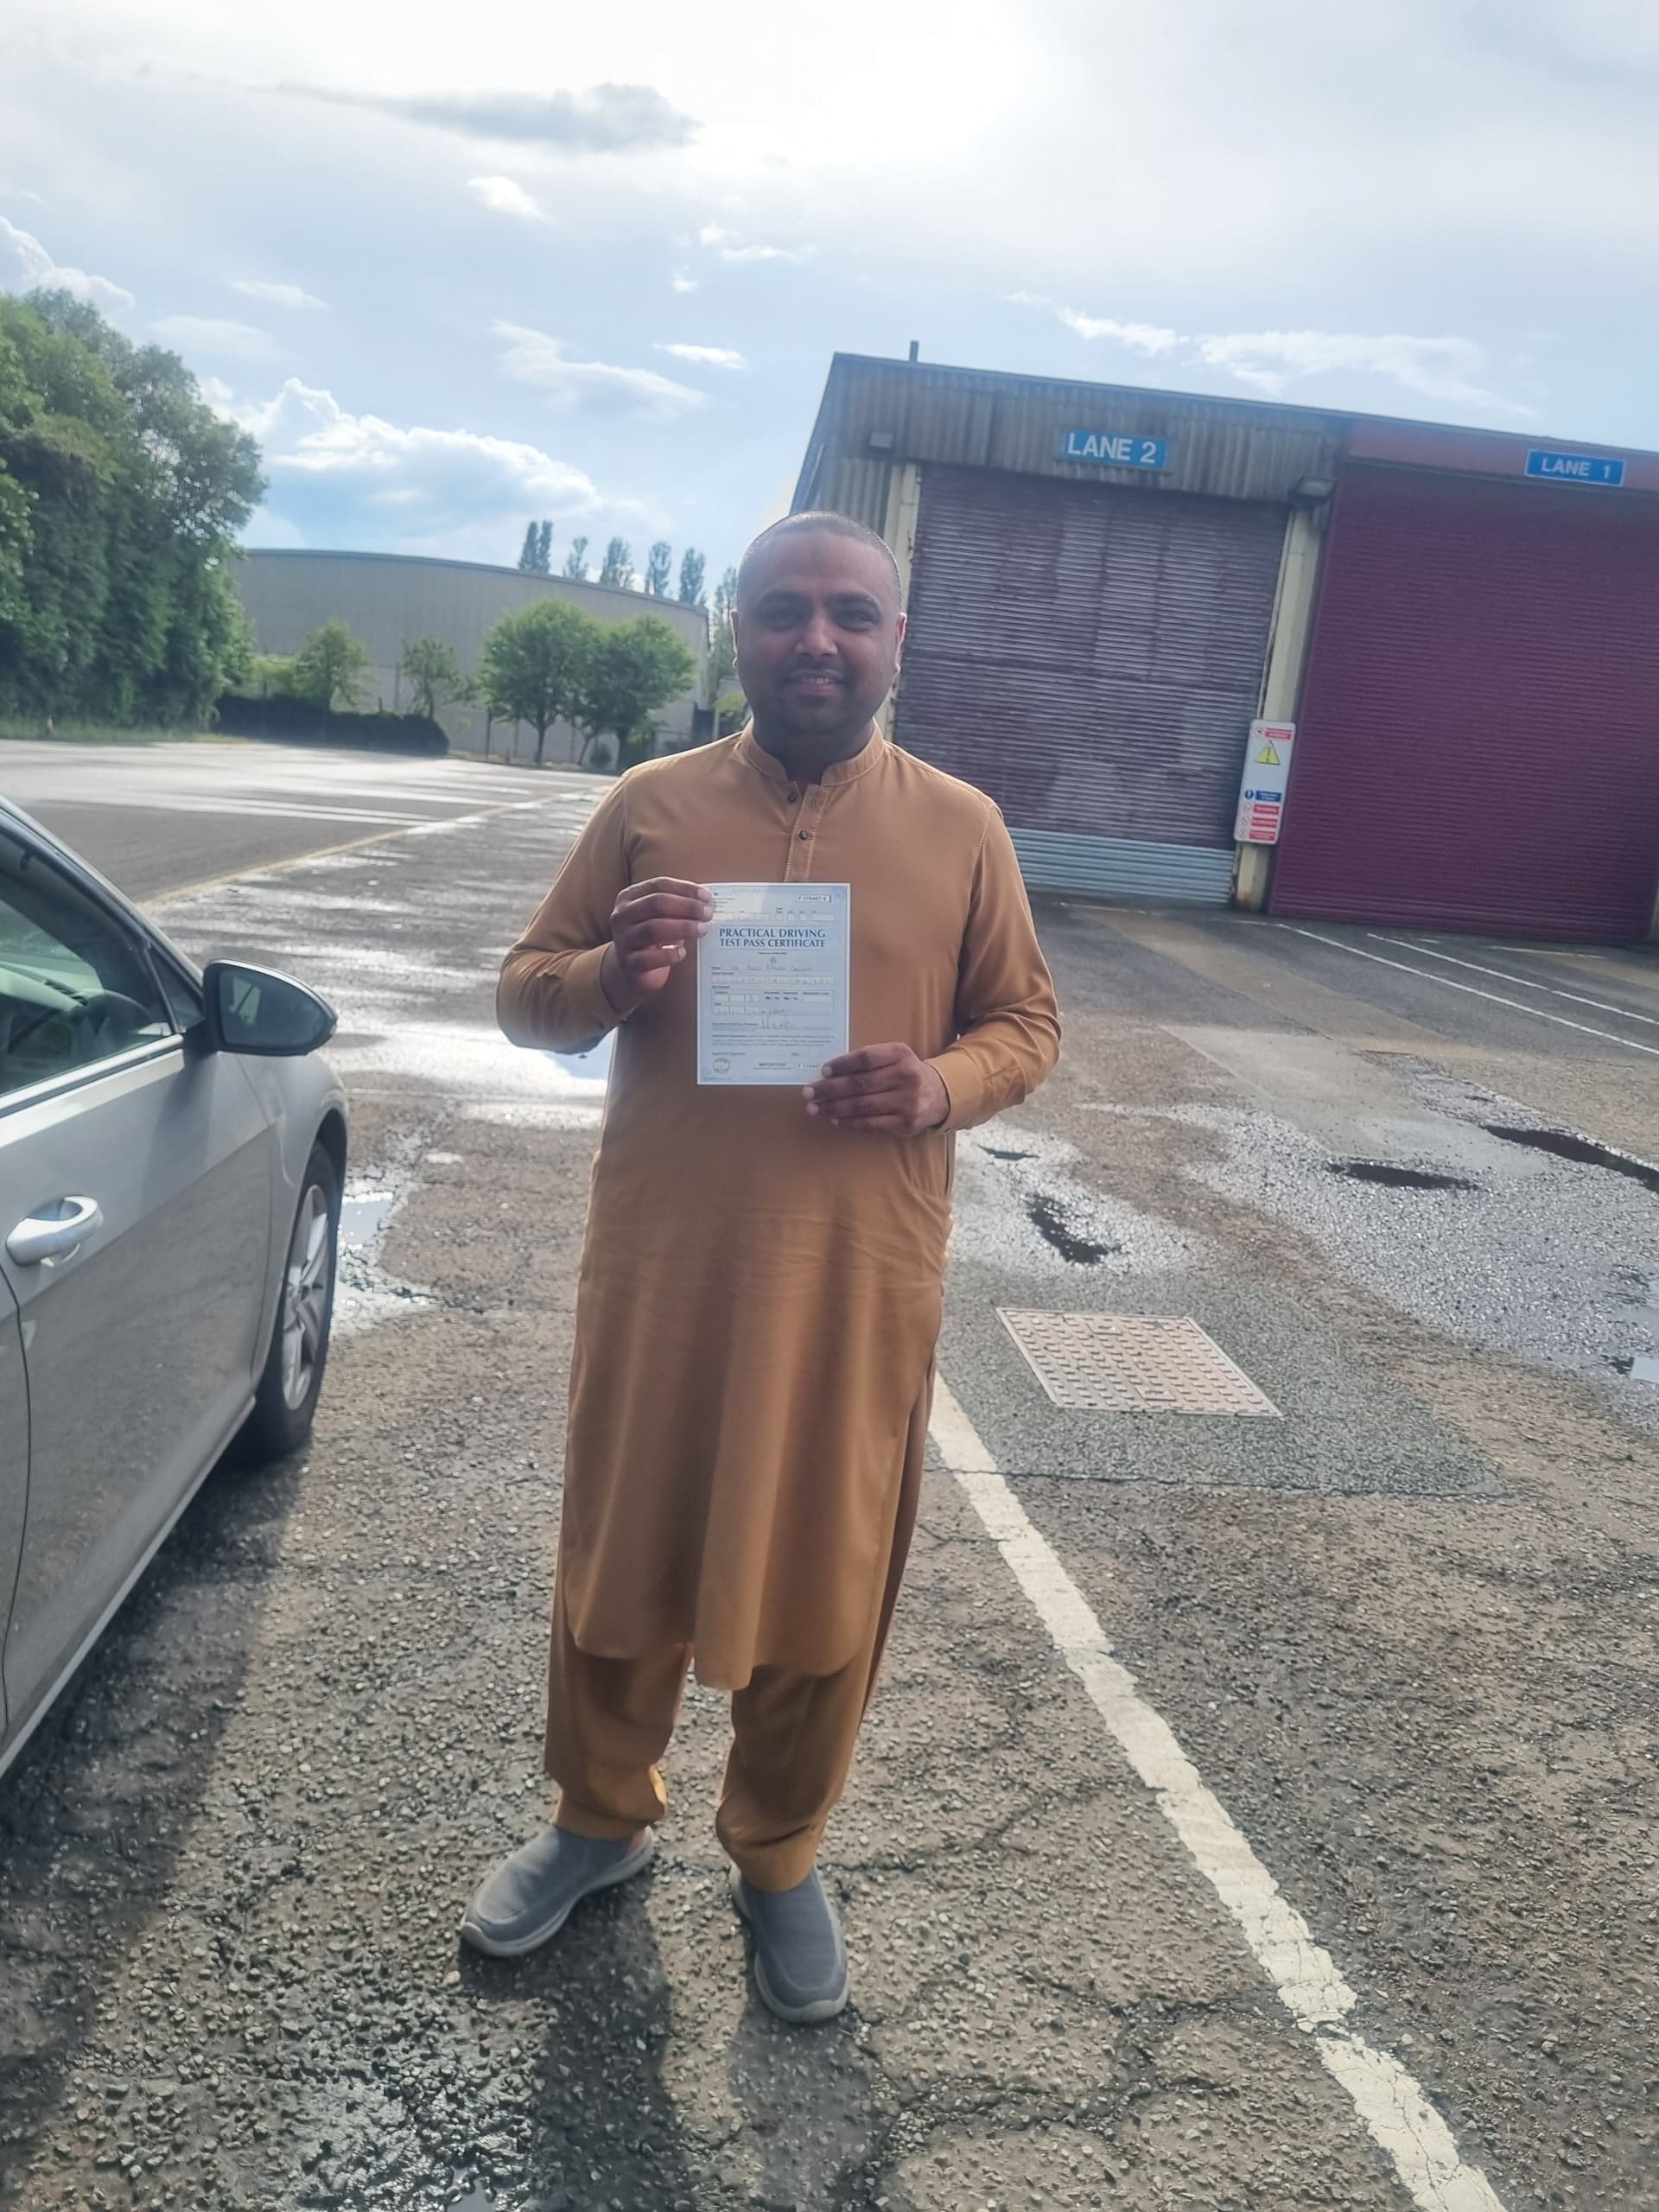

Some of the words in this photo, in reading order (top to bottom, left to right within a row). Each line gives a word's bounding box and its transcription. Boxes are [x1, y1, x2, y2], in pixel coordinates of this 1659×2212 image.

[1067, 432, 1133, 461] LANE
[1140, 441, 1157, 464] 2
[1541, 456, 1591, 477] LANE
[1603, 464, 1611, 479] 1
[719, 928, 775, 938] PRACTICAL
[779, 928, 826, 938] DRIVING
[720, 938, 740, 947] TEST
[743, 938, 766, 947] PASS
[768, 938, 826, 948] CERTIFICATE
